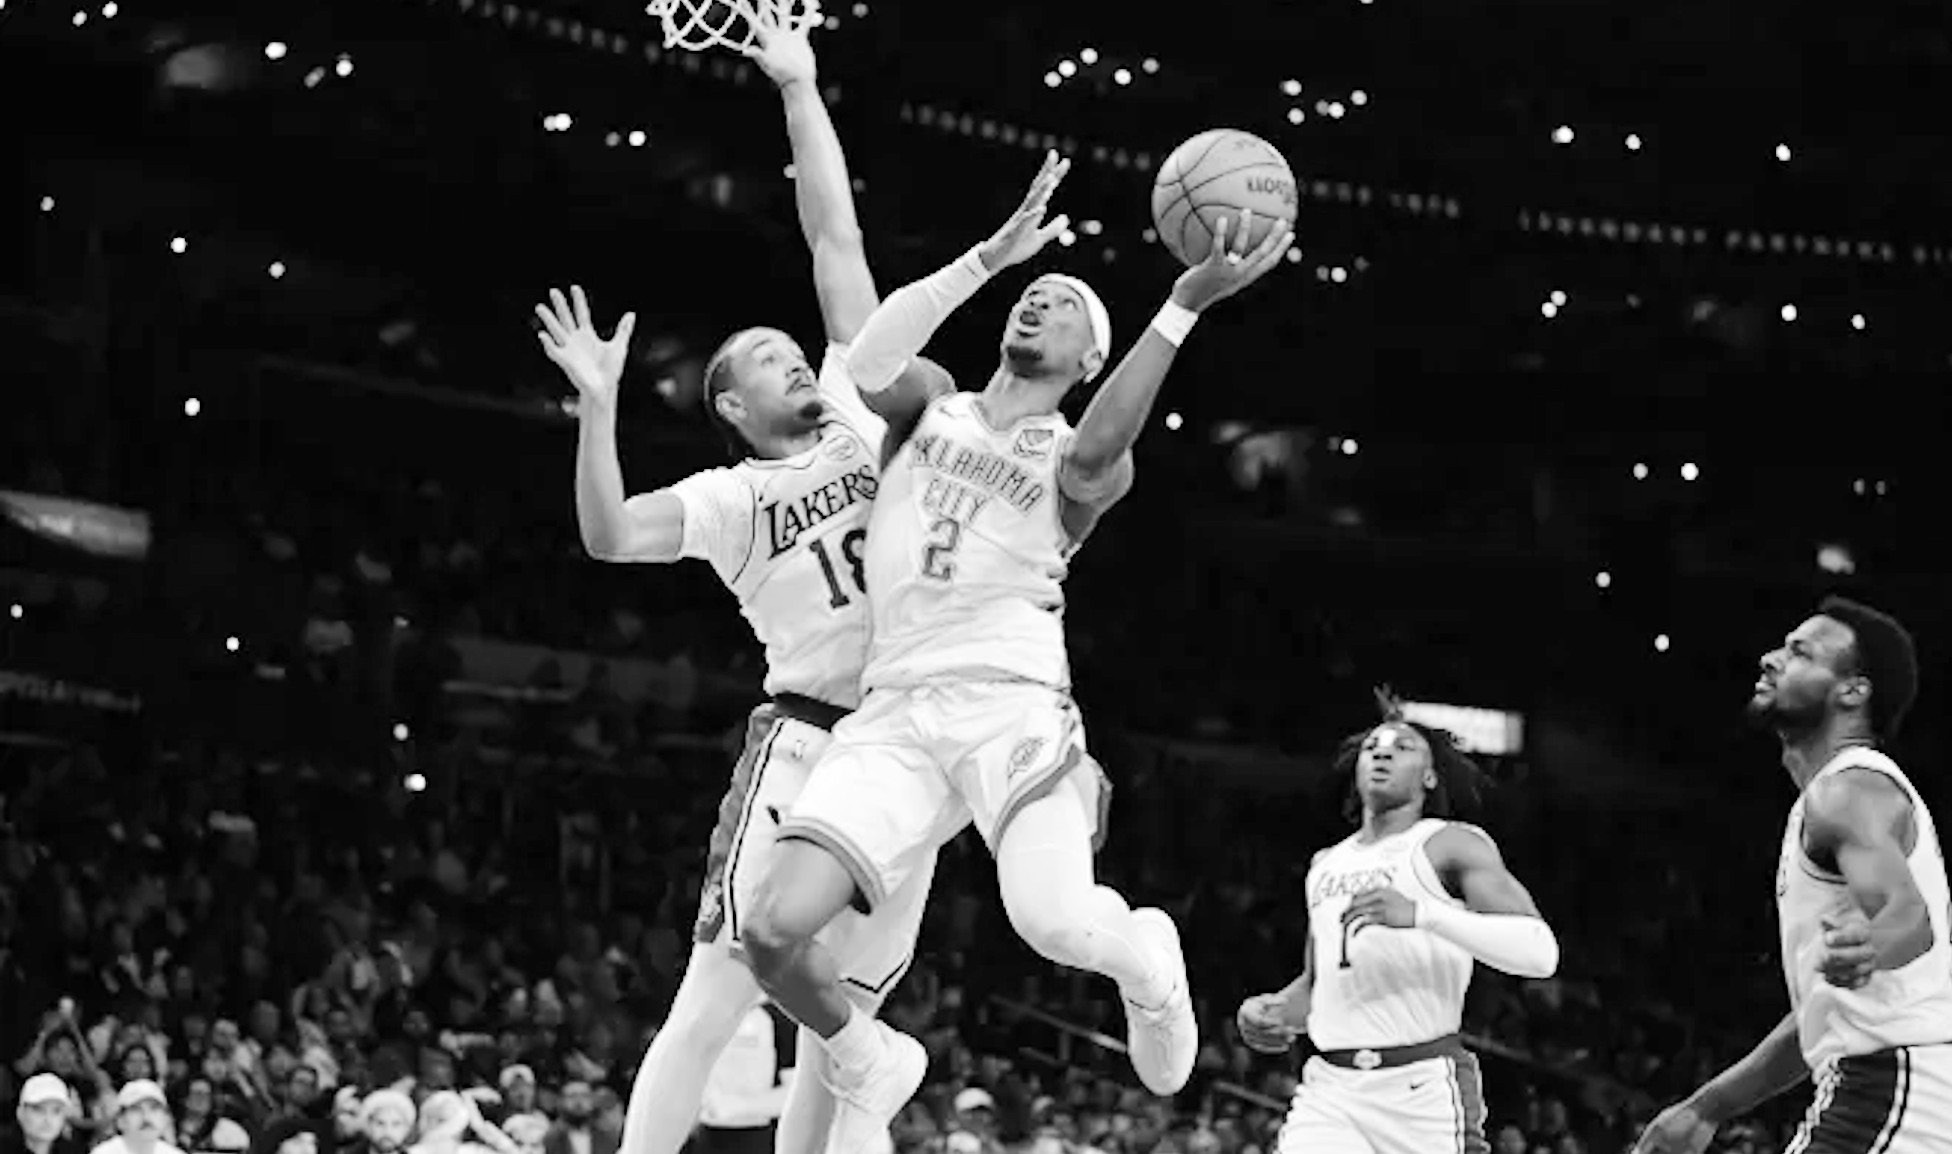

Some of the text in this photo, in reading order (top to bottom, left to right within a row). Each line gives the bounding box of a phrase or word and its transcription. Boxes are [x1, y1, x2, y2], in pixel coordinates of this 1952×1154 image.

[914, 435, 1046, 517] KLAHOMA
[922, 478, 987, 527] CITY
[762, 465, 879, 561] LAKERS
[922, 517, 960, 581] 2
